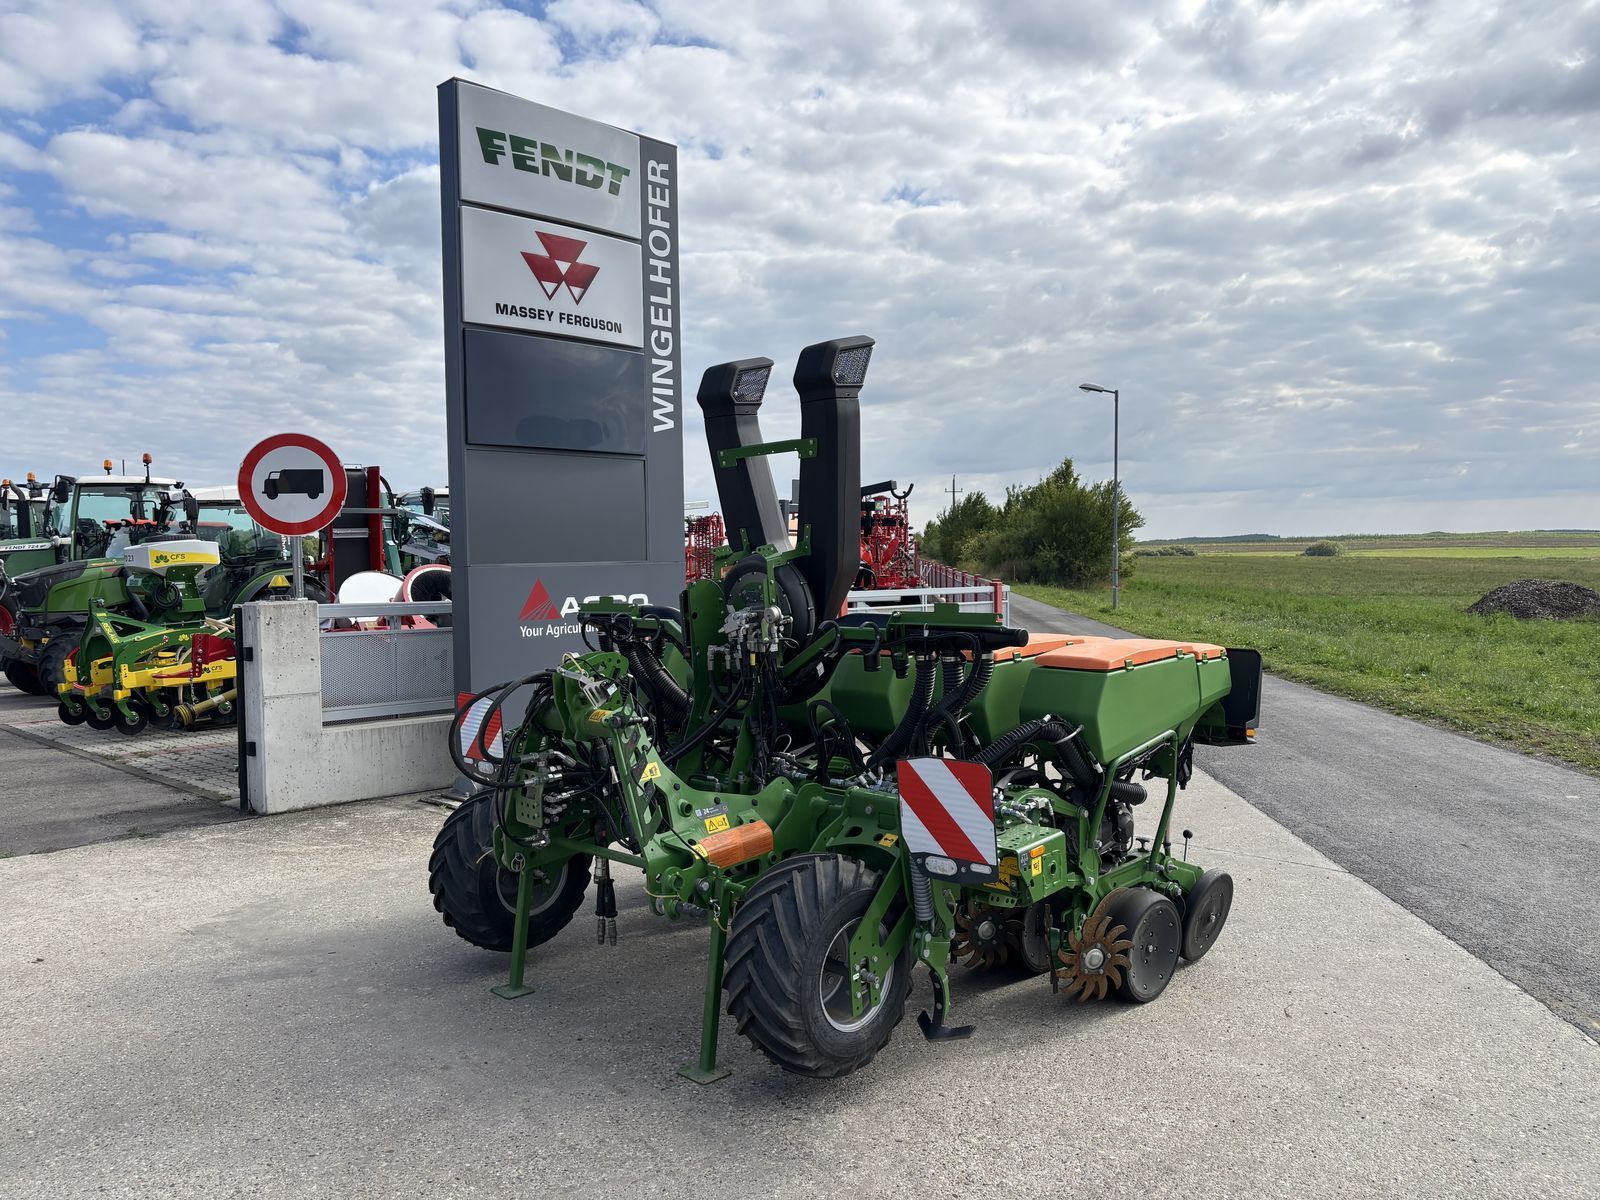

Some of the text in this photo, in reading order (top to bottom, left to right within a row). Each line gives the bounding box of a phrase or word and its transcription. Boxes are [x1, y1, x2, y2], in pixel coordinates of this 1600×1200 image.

[476, 127, 630, 196] FENDT
[495, 302, 622, 333] MASSEY FERGUSON
[647, 159, 675, 432] WINGELHOFER
[520, 625, 544, 638] Your
